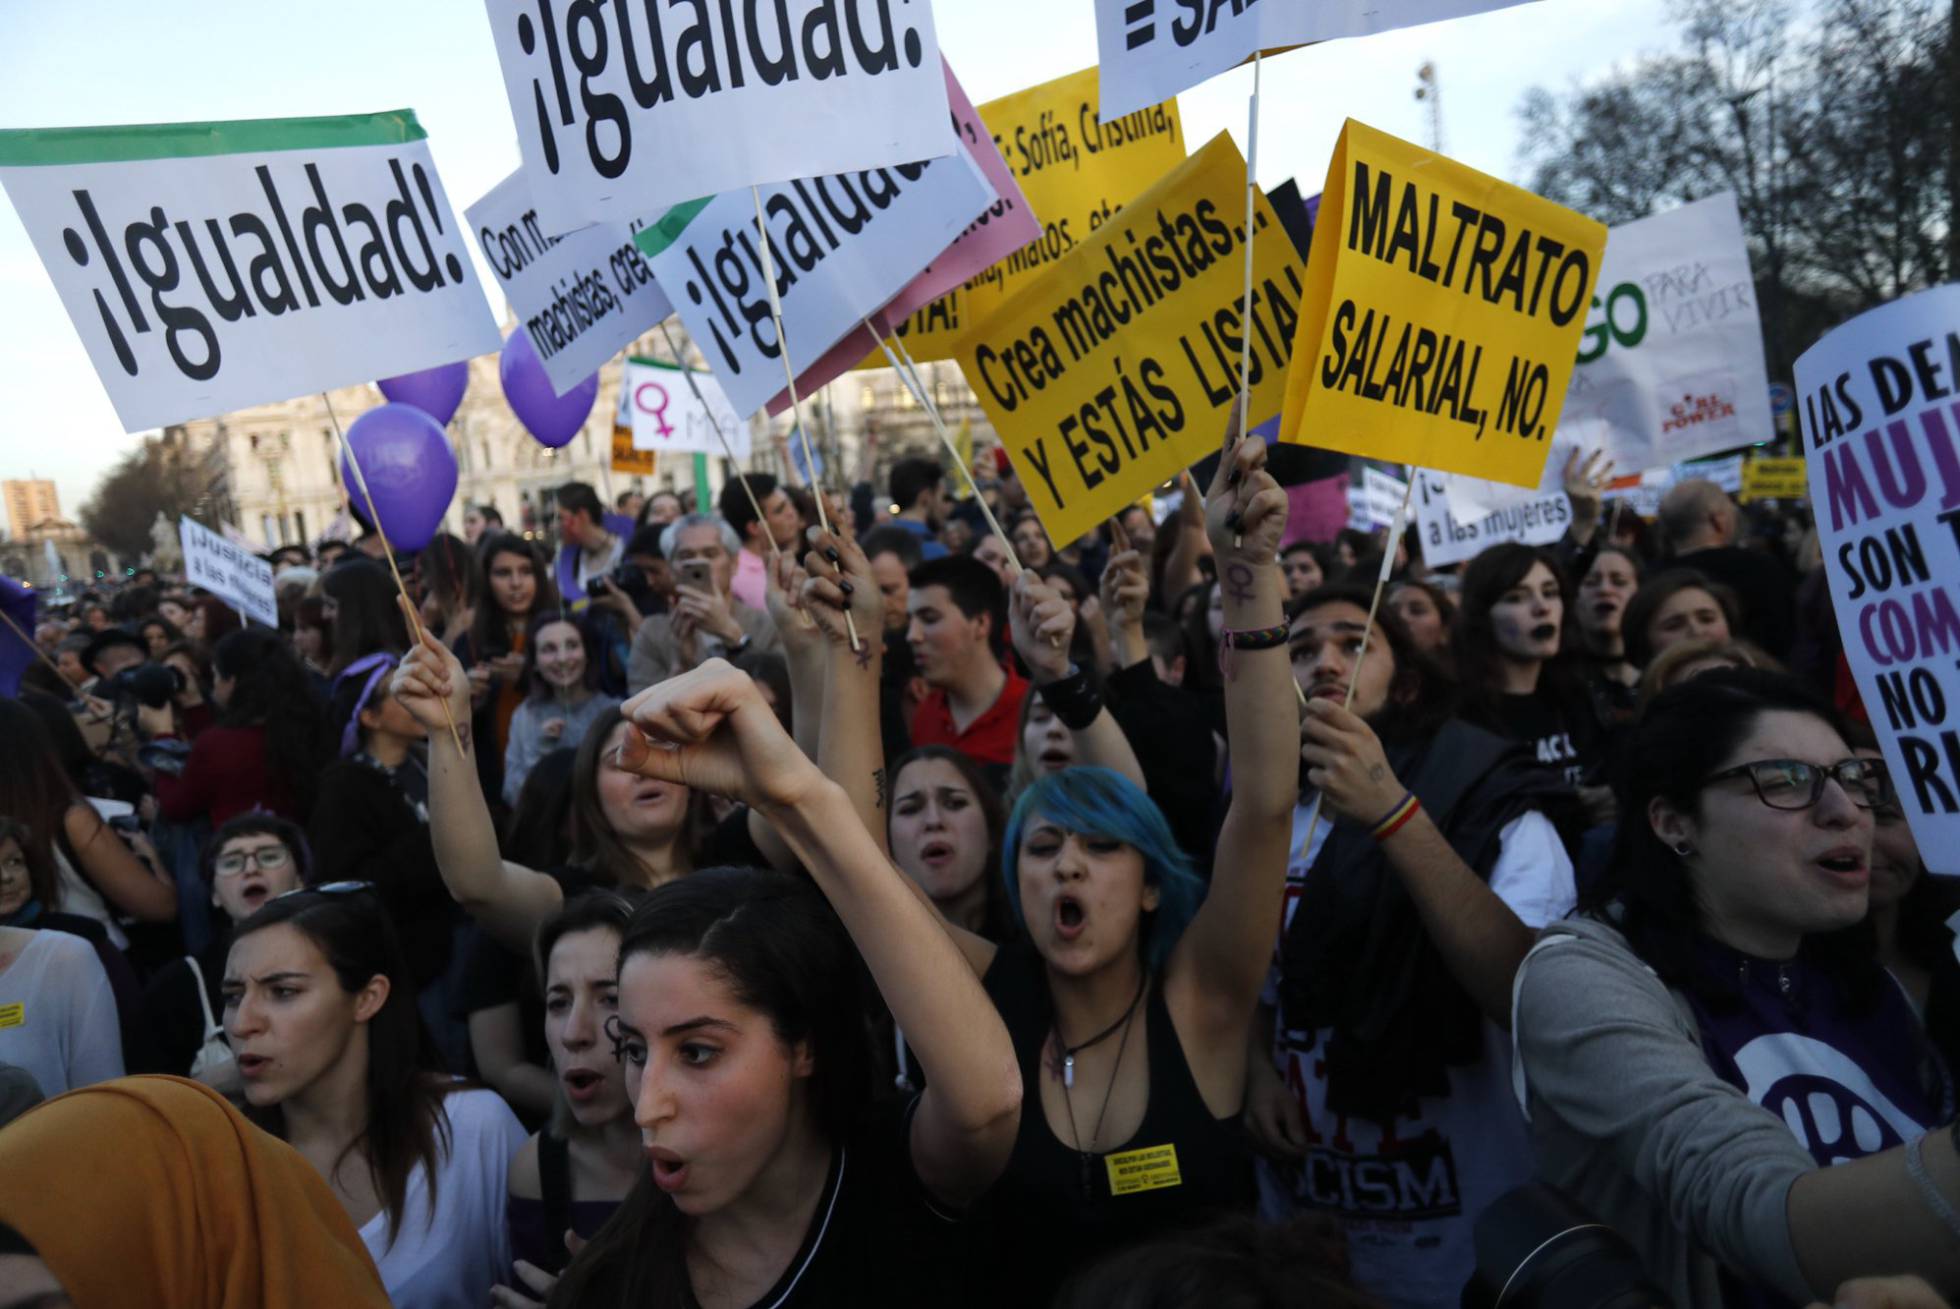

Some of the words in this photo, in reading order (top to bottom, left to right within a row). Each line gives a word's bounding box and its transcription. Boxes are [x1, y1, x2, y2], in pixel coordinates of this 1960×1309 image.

[1015, 110, 1079, 171] Sofía,
[63, 158, 464, 381] ¡Igualdad!
[481, 225, 535, 280] Con
[1348, 160, 1589, 327] MALTRATO
[527, 268, 623, 360] machistas,
[975, 326, 1065, 411] Crea
[1322, 299, 1488, 441] SALARIAL,
[1495, 355, 1548, 441] NO.
[1023, 438, 1065, 510] Y
[1058, 356, 1185, 490] ESTÁS
[1806, 371, 1863, 450] LAS
[1428, 523, 1441, 546] a
[1484, 497, 1568, 538] mujeres
[1839, 522, 1931, 600] SON
[1875, 666, 1947, 731] NO
